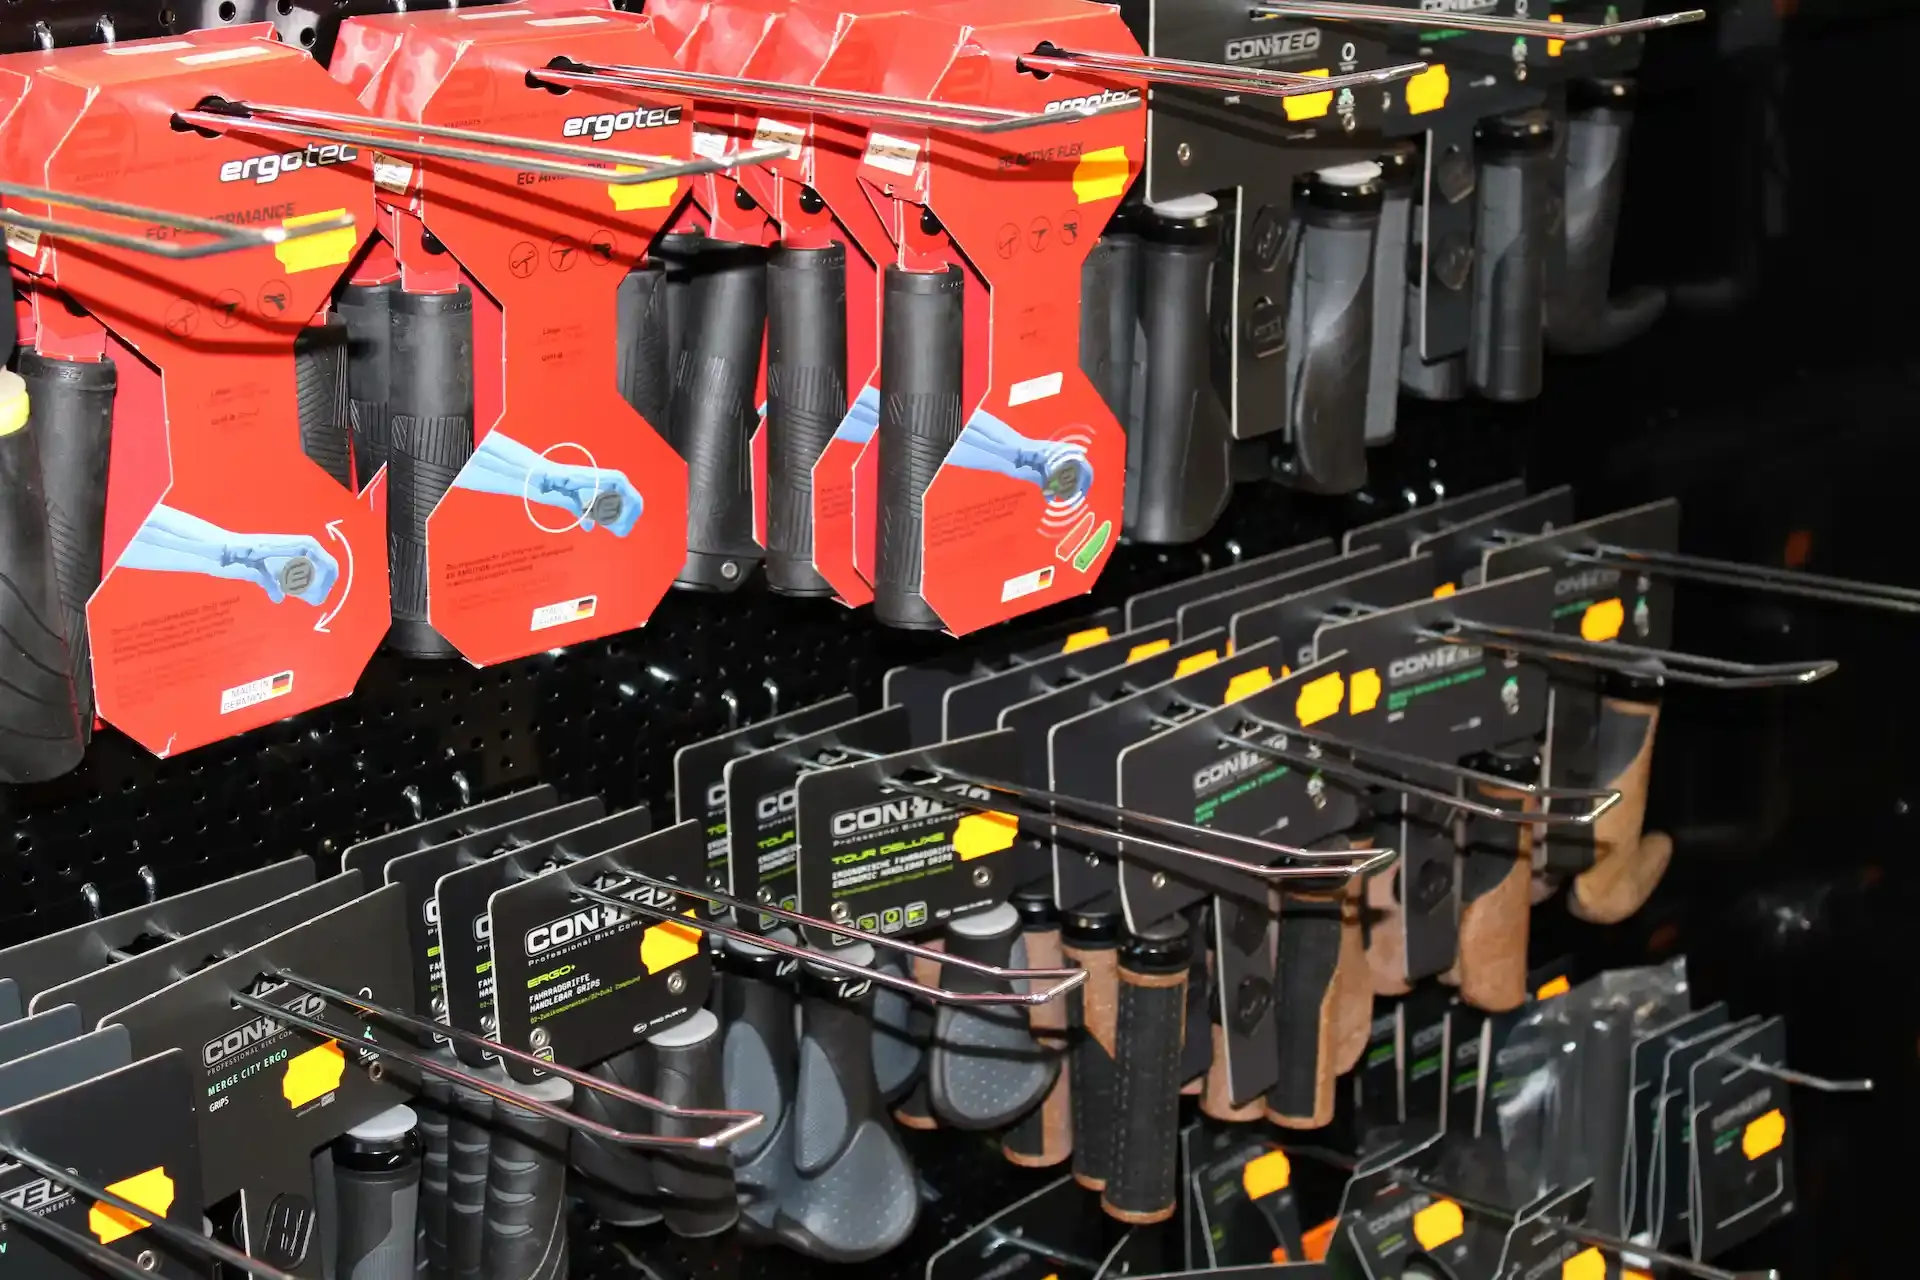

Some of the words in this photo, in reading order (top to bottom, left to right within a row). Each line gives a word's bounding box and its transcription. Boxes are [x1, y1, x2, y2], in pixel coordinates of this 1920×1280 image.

[563, 105, 682, 141] ergotec
[219, 142, 358, 184] ergotec
[831, 848, 877, 865] TOUR
[879, 832, 945, 856] DELUXE
[528, 937, 592, 968] Professional
[594, 927, 616, 942] Bike
[529, 973, 591, 1004] FAHRRADGRIFFE
[530, 990, 573, 1014] HANDLEBAR
[576, 978, 601, 995] GRIPS
[207, 1045, 258, 1077] PROFESSIONAL
[261, 1037, 277, 1050] BIKE
[207, 1073, 239, 1098] MERGE
[241, 1062, 262, 1080] CITY
[264, 1048, 288, 1069] ERGO
[208, 1095, 230, 1114] GRIPS
